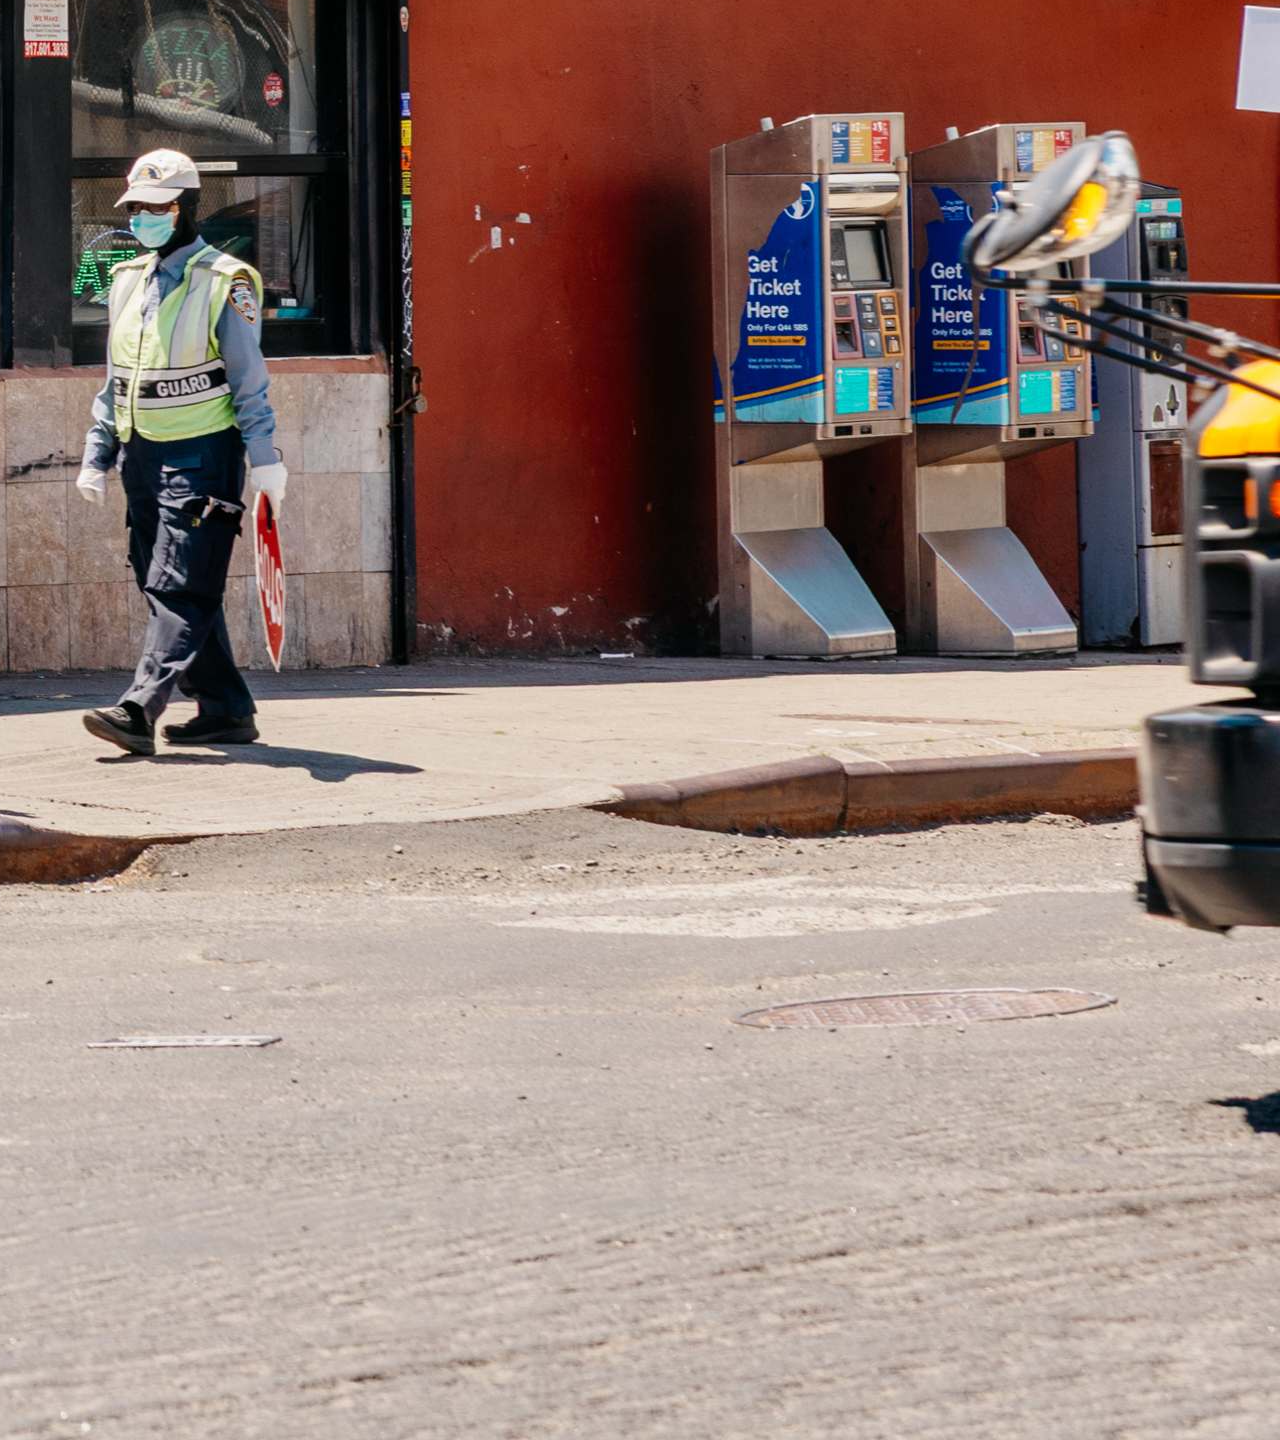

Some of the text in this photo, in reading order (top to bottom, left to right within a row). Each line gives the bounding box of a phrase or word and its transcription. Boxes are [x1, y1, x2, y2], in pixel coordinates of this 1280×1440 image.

[747, 255, 778, 273] Get
[931, 262, 963, 279] Get
[749, 279, 802, 295] Ticket
[746, 301, 790, 319] Here
[932, 307, 973, 324] Here
[156, 373, 211, 397] GUARD
